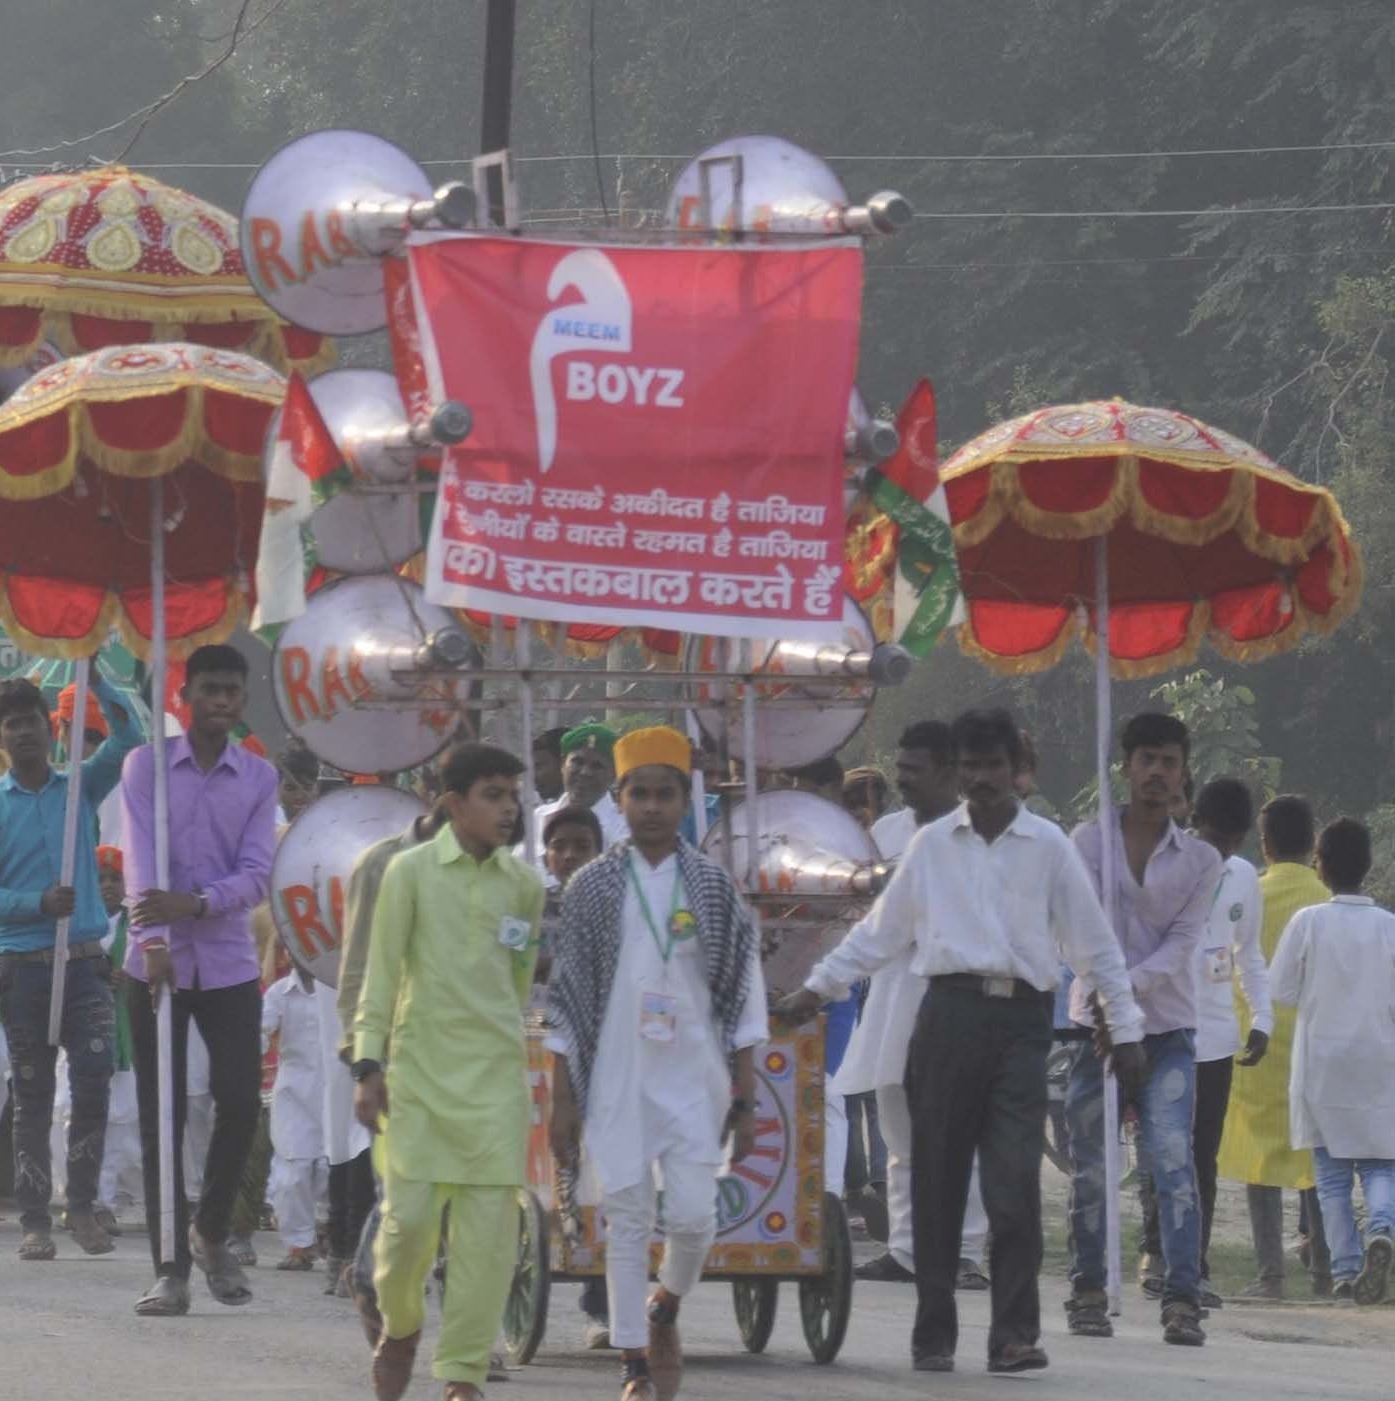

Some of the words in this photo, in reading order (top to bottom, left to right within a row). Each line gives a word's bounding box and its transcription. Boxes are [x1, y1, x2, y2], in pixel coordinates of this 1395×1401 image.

[553, 320, 621, 341] MEEM
[567, 361, 684, 408] BOYZ
[711, 492, 731, 522] है
[737, 495, 826, 526] ताजिया
[533, 517, 561, 541] के
[712, 527, 733, 557] है
[739, 530, 829, 560] ताजिया
[500, 555, 693, 604] इस्तकबाल
[700, 563, 795, 610] करते
[803, 564, 842, 615] हैं
